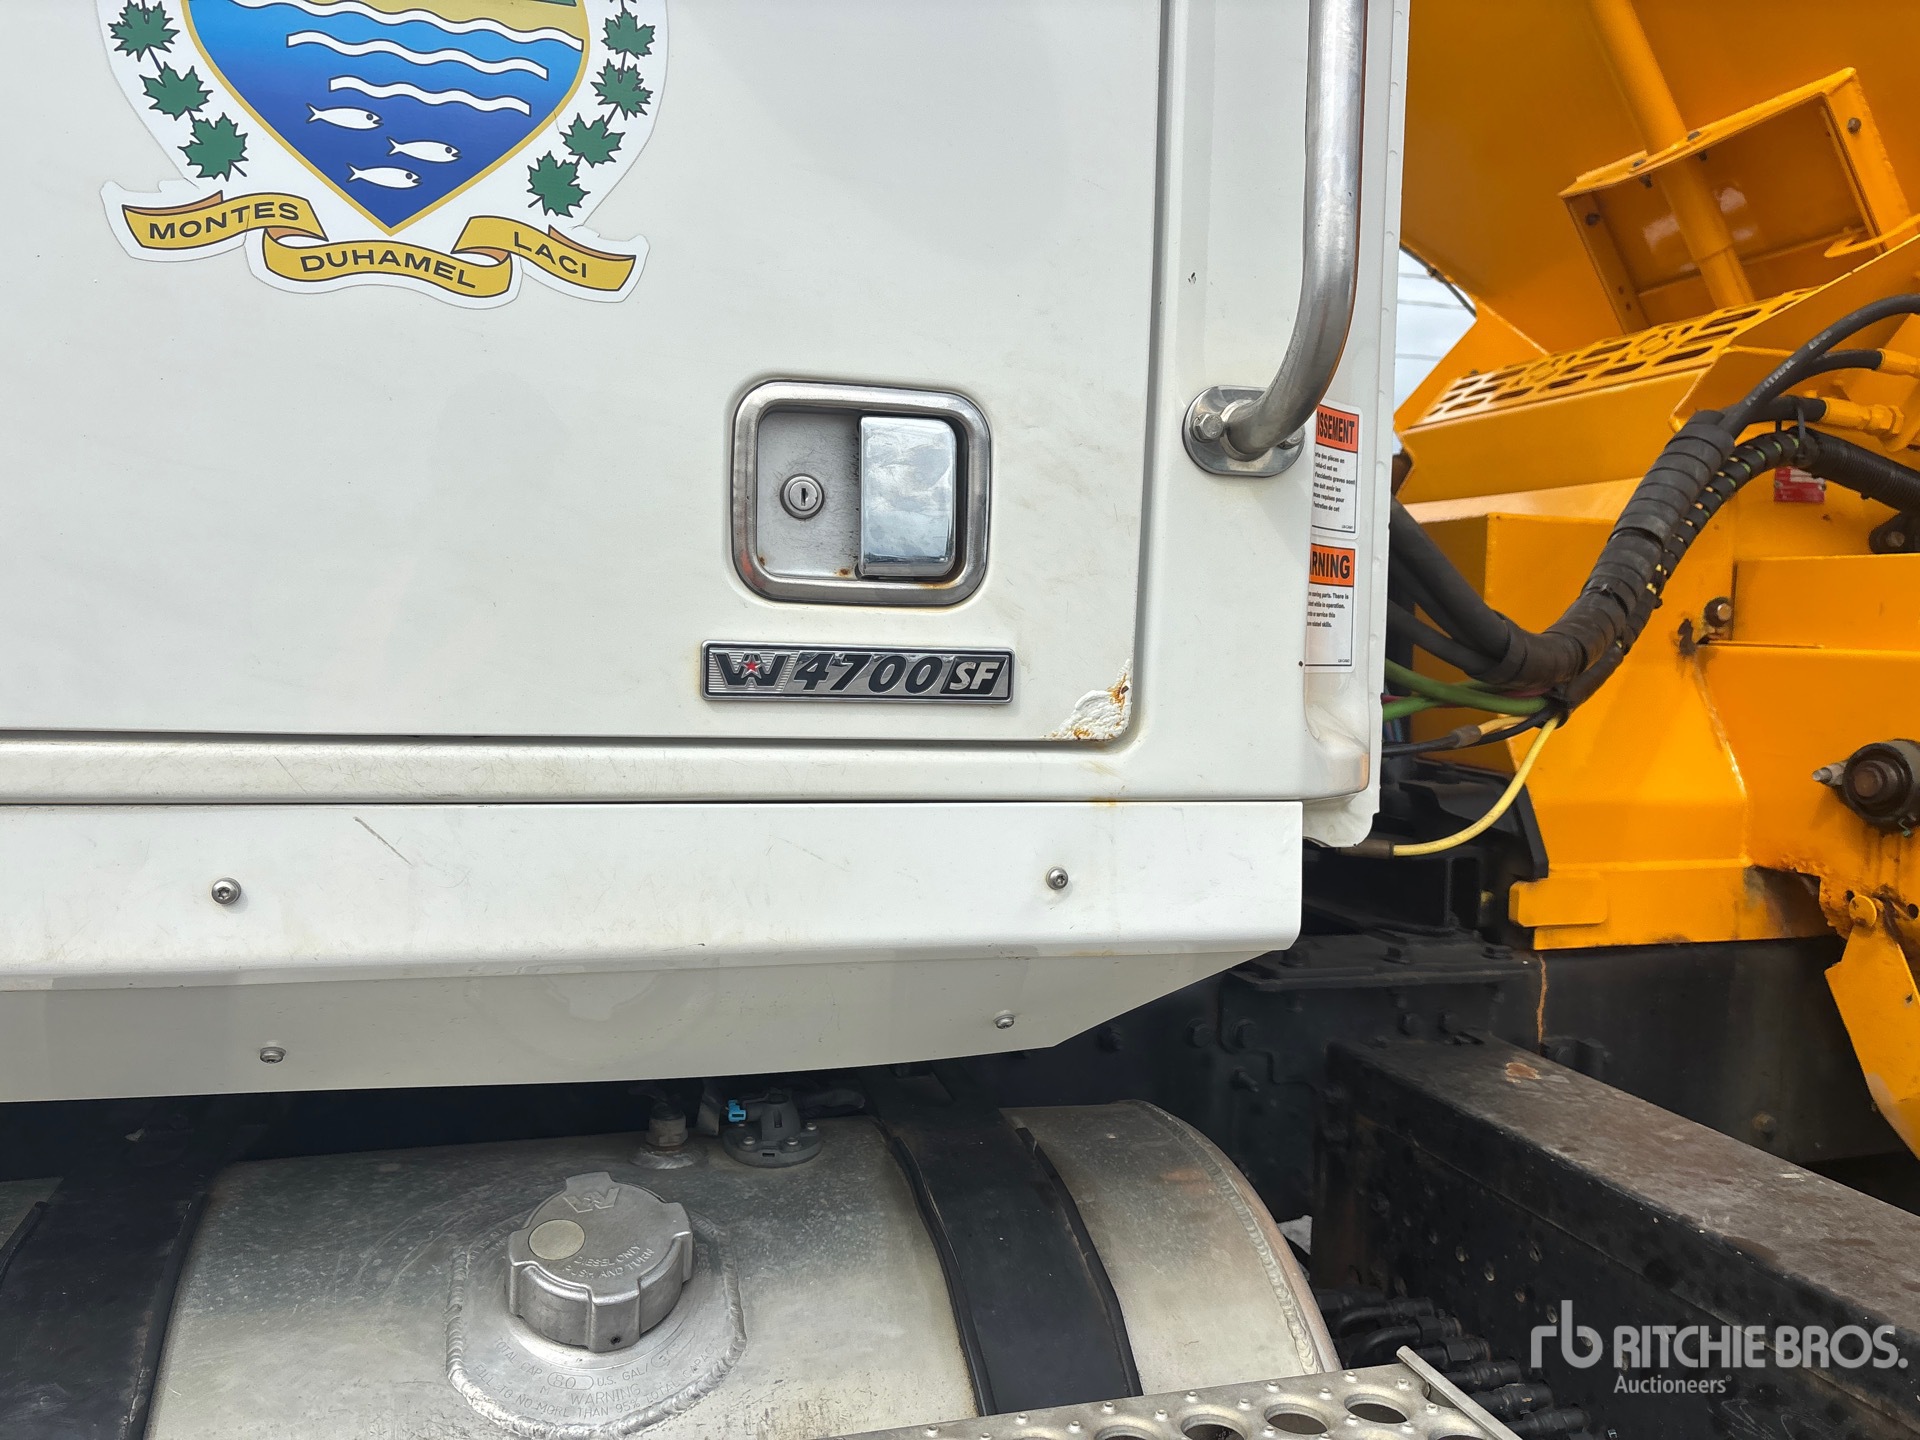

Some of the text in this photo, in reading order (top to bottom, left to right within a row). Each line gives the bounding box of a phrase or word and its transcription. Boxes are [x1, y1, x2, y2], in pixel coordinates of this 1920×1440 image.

[149, 201, 300, 240] MONTES
[300, 249, 476, 289] DUHAMEL
[513, 230, 589, 278] LACI
[1311, 551, 1350, 579] RNING
[793, 651, 944, 696] 4700
[949, 661, 1001, 692] SF
[570, 1383, 641, 1406] WARNING
